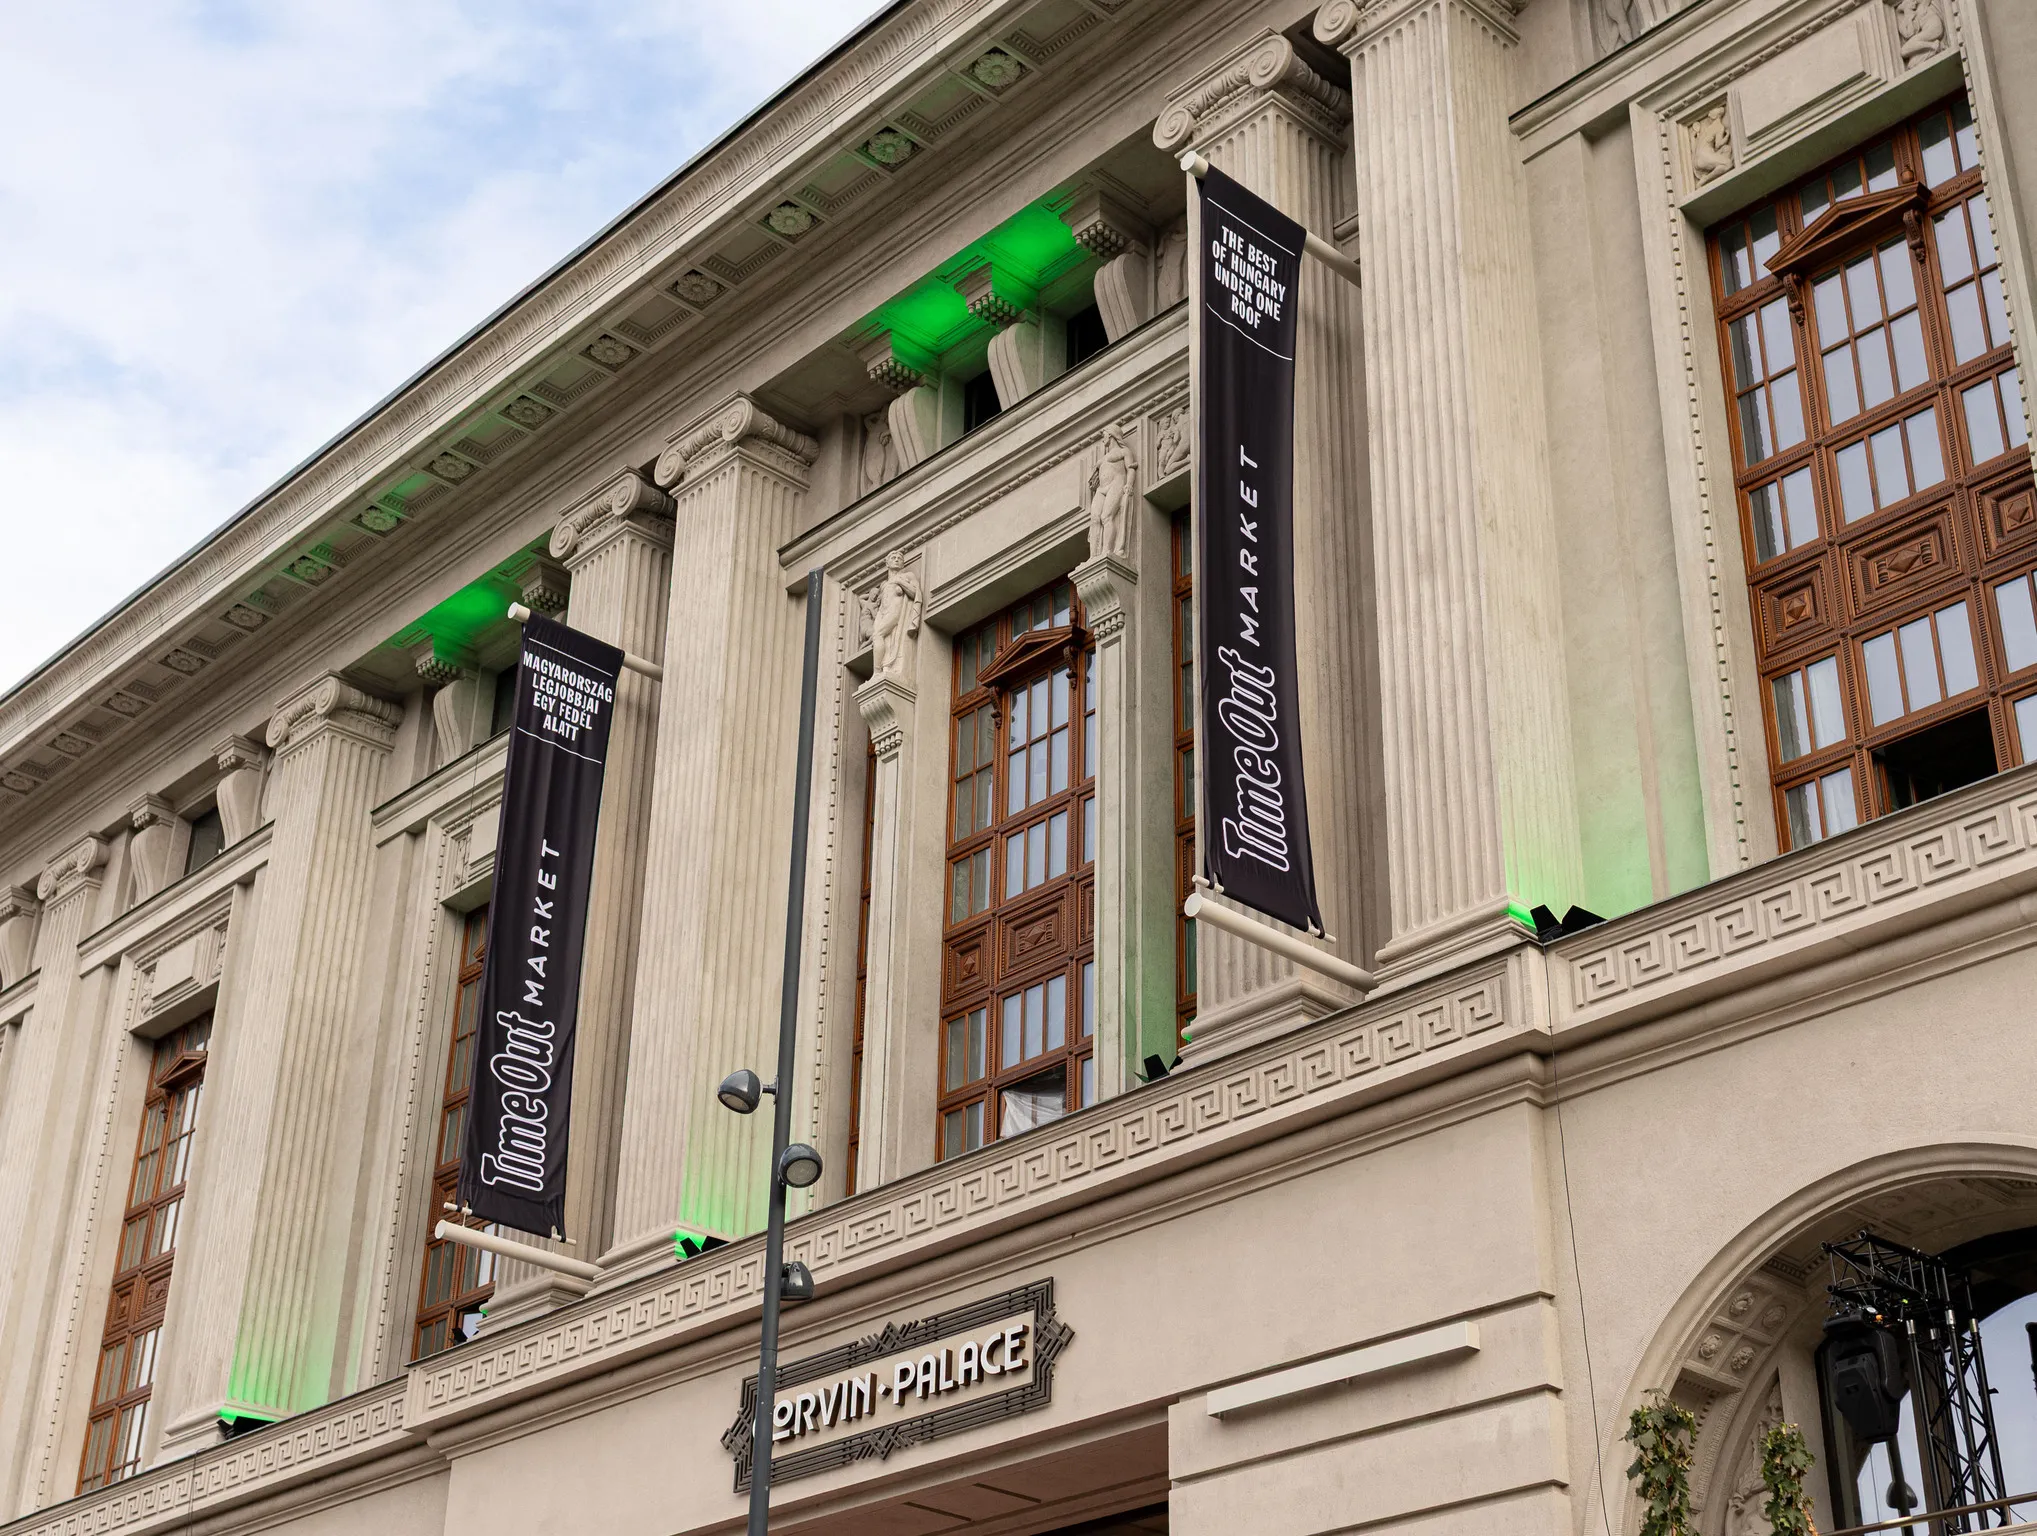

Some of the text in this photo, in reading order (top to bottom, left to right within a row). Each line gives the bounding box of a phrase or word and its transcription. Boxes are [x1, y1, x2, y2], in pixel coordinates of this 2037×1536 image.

[1212, 240, 1286, 302] OF HUNGARY
[1221, 225, 1277, 276] THE BEST
[1214, 261, 1281, 321] UNDER ONE
[1231, 294, 1261, 329] ROOF
[1239, 444, 1260, 647] MARKET
[523, 650, 613, 703] MAGYARORSZÁG
[532, 672, 599, 714] LEGJOBBJAI
[533, 691, 592, 730] EGY FEDÉL
[543, 714, 579, 741] ALATT
[523, 838, 560, 1007] MARKET
[752, 1323, 1029, 1441] ORVIN PALACE
